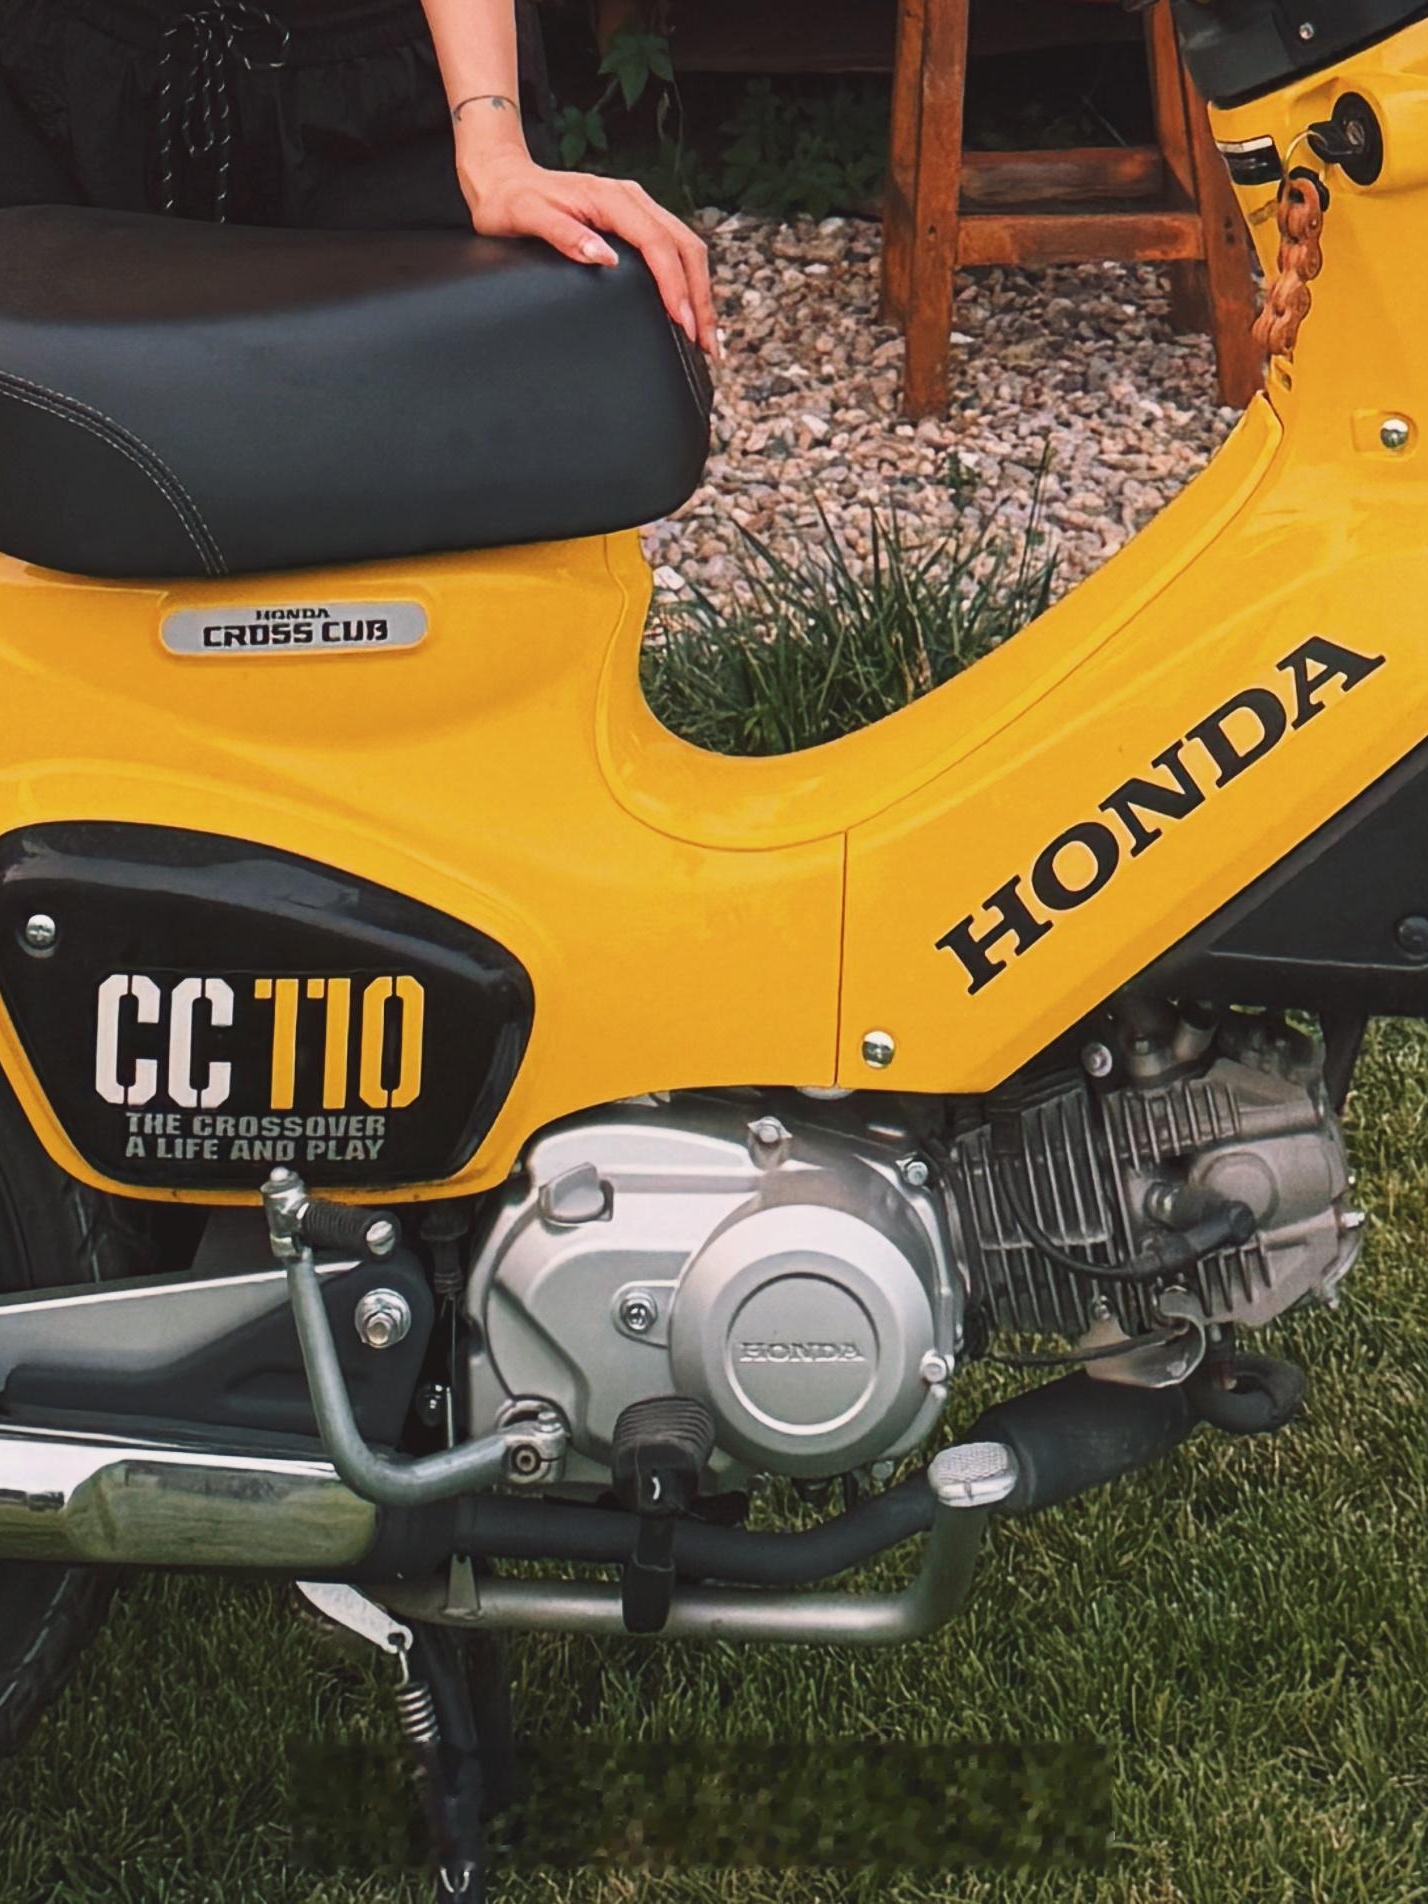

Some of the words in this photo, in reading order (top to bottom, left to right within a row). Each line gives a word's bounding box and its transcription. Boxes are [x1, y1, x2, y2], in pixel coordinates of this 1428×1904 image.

[256, 607, 330, 621] HONDA
[203, 623, 313, 647] CROSS
[322, 619, 388, 642] CUB
[934, 635, 1387, 996] HONDA
[125, 1112, 181, 1135] THE
[192, 1115, 386, 1136] CROSSOVER
[125, 1137, 146, 1158] A
[157, 1138, 219, 1159] LIFE
[230, 1140, 295, 1161] AND
[306, 1140, 385, 1160] PLAY
[738, 1342, 867, 1362] HONDA
